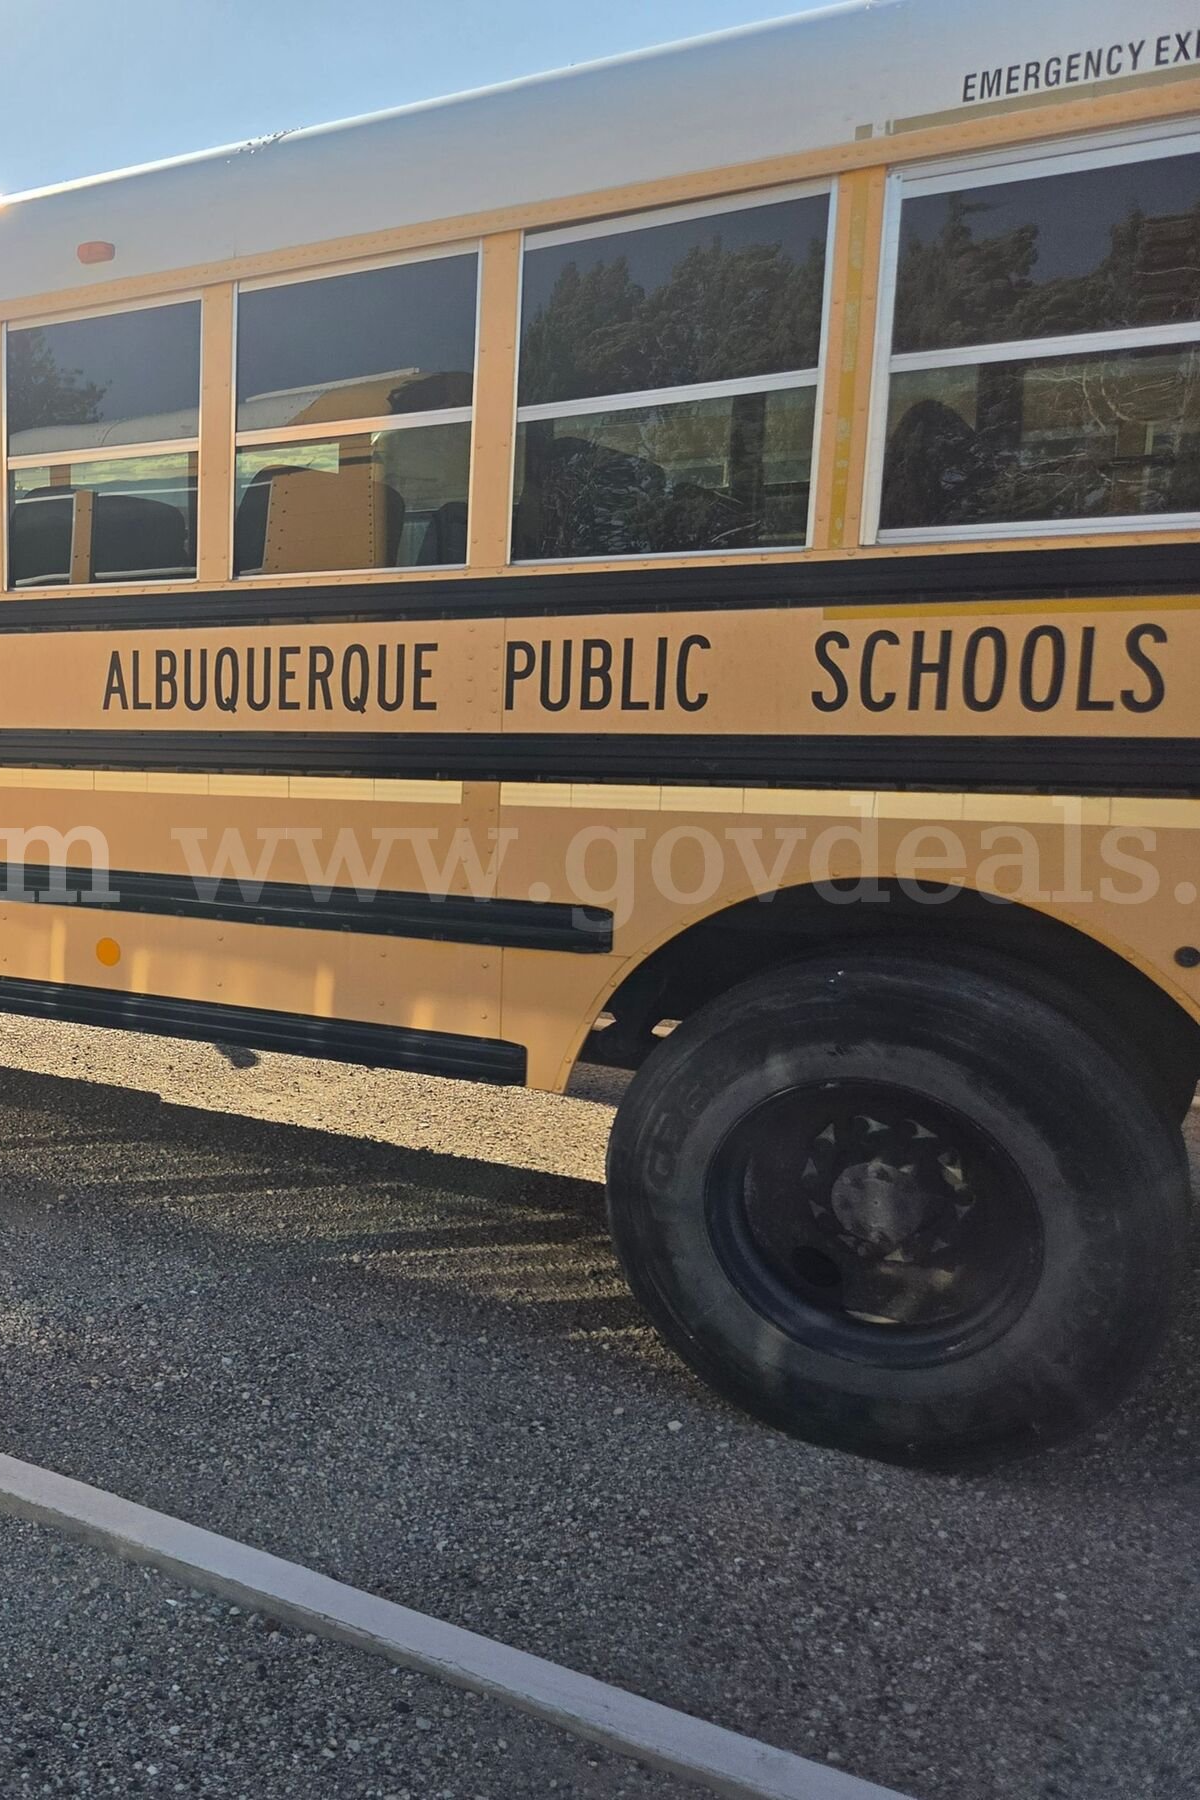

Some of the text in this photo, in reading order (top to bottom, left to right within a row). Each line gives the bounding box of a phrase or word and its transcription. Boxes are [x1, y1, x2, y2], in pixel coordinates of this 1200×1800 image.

[963, 40, 1145, 102] EMERGENCY
[103, 623, 1168, 714] ALBUQUERQUE PUBLIC SCHOOLS
